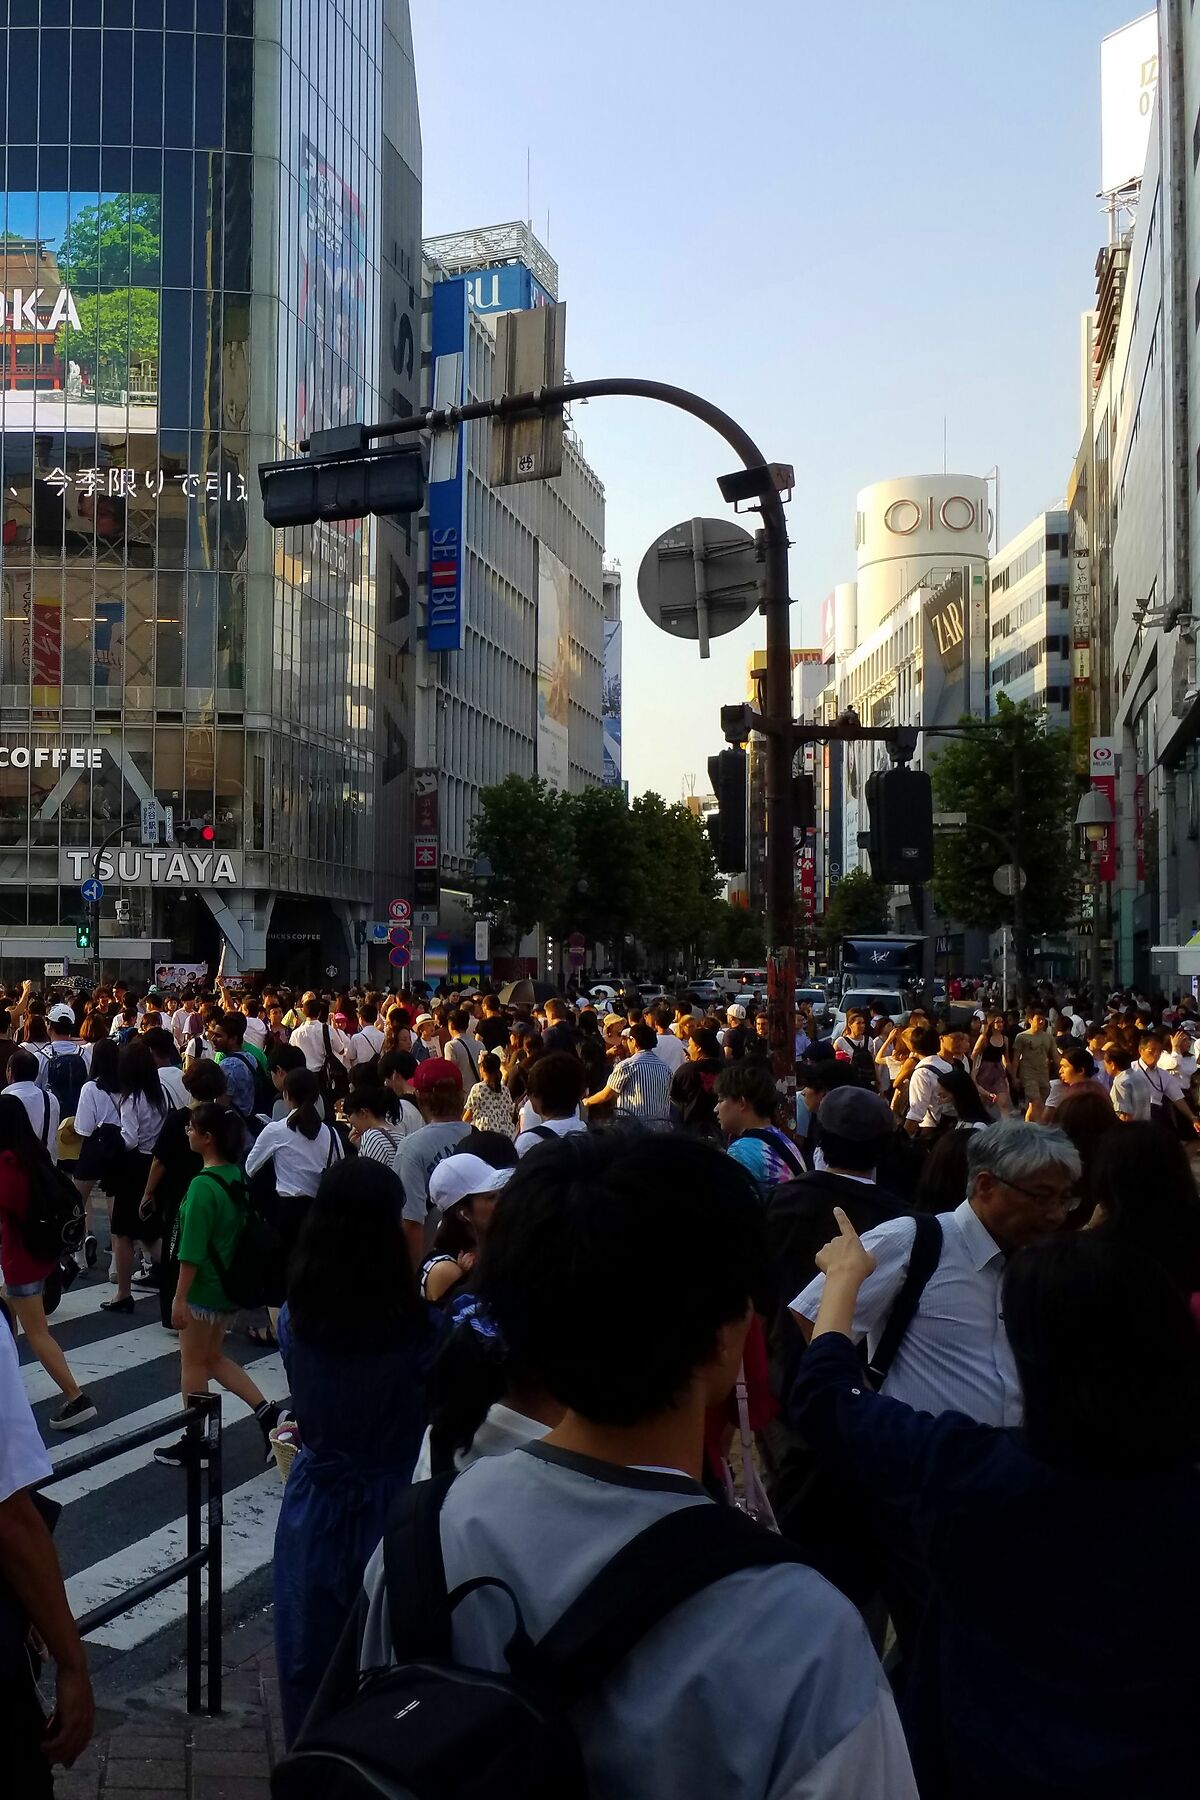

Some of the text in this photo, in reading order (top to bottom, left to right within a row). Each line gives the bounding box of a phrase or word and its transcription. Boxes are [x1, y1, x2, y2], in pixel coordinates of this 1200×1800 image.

[432, 528, 458, 628] SEIBU
[931, 596, 964, 655] ZAR
[147, 801, 157, 840] 渋谷駅前
[66, 850, 237, 885] TSUTAYA
[418, 848, 434, 864] 本
